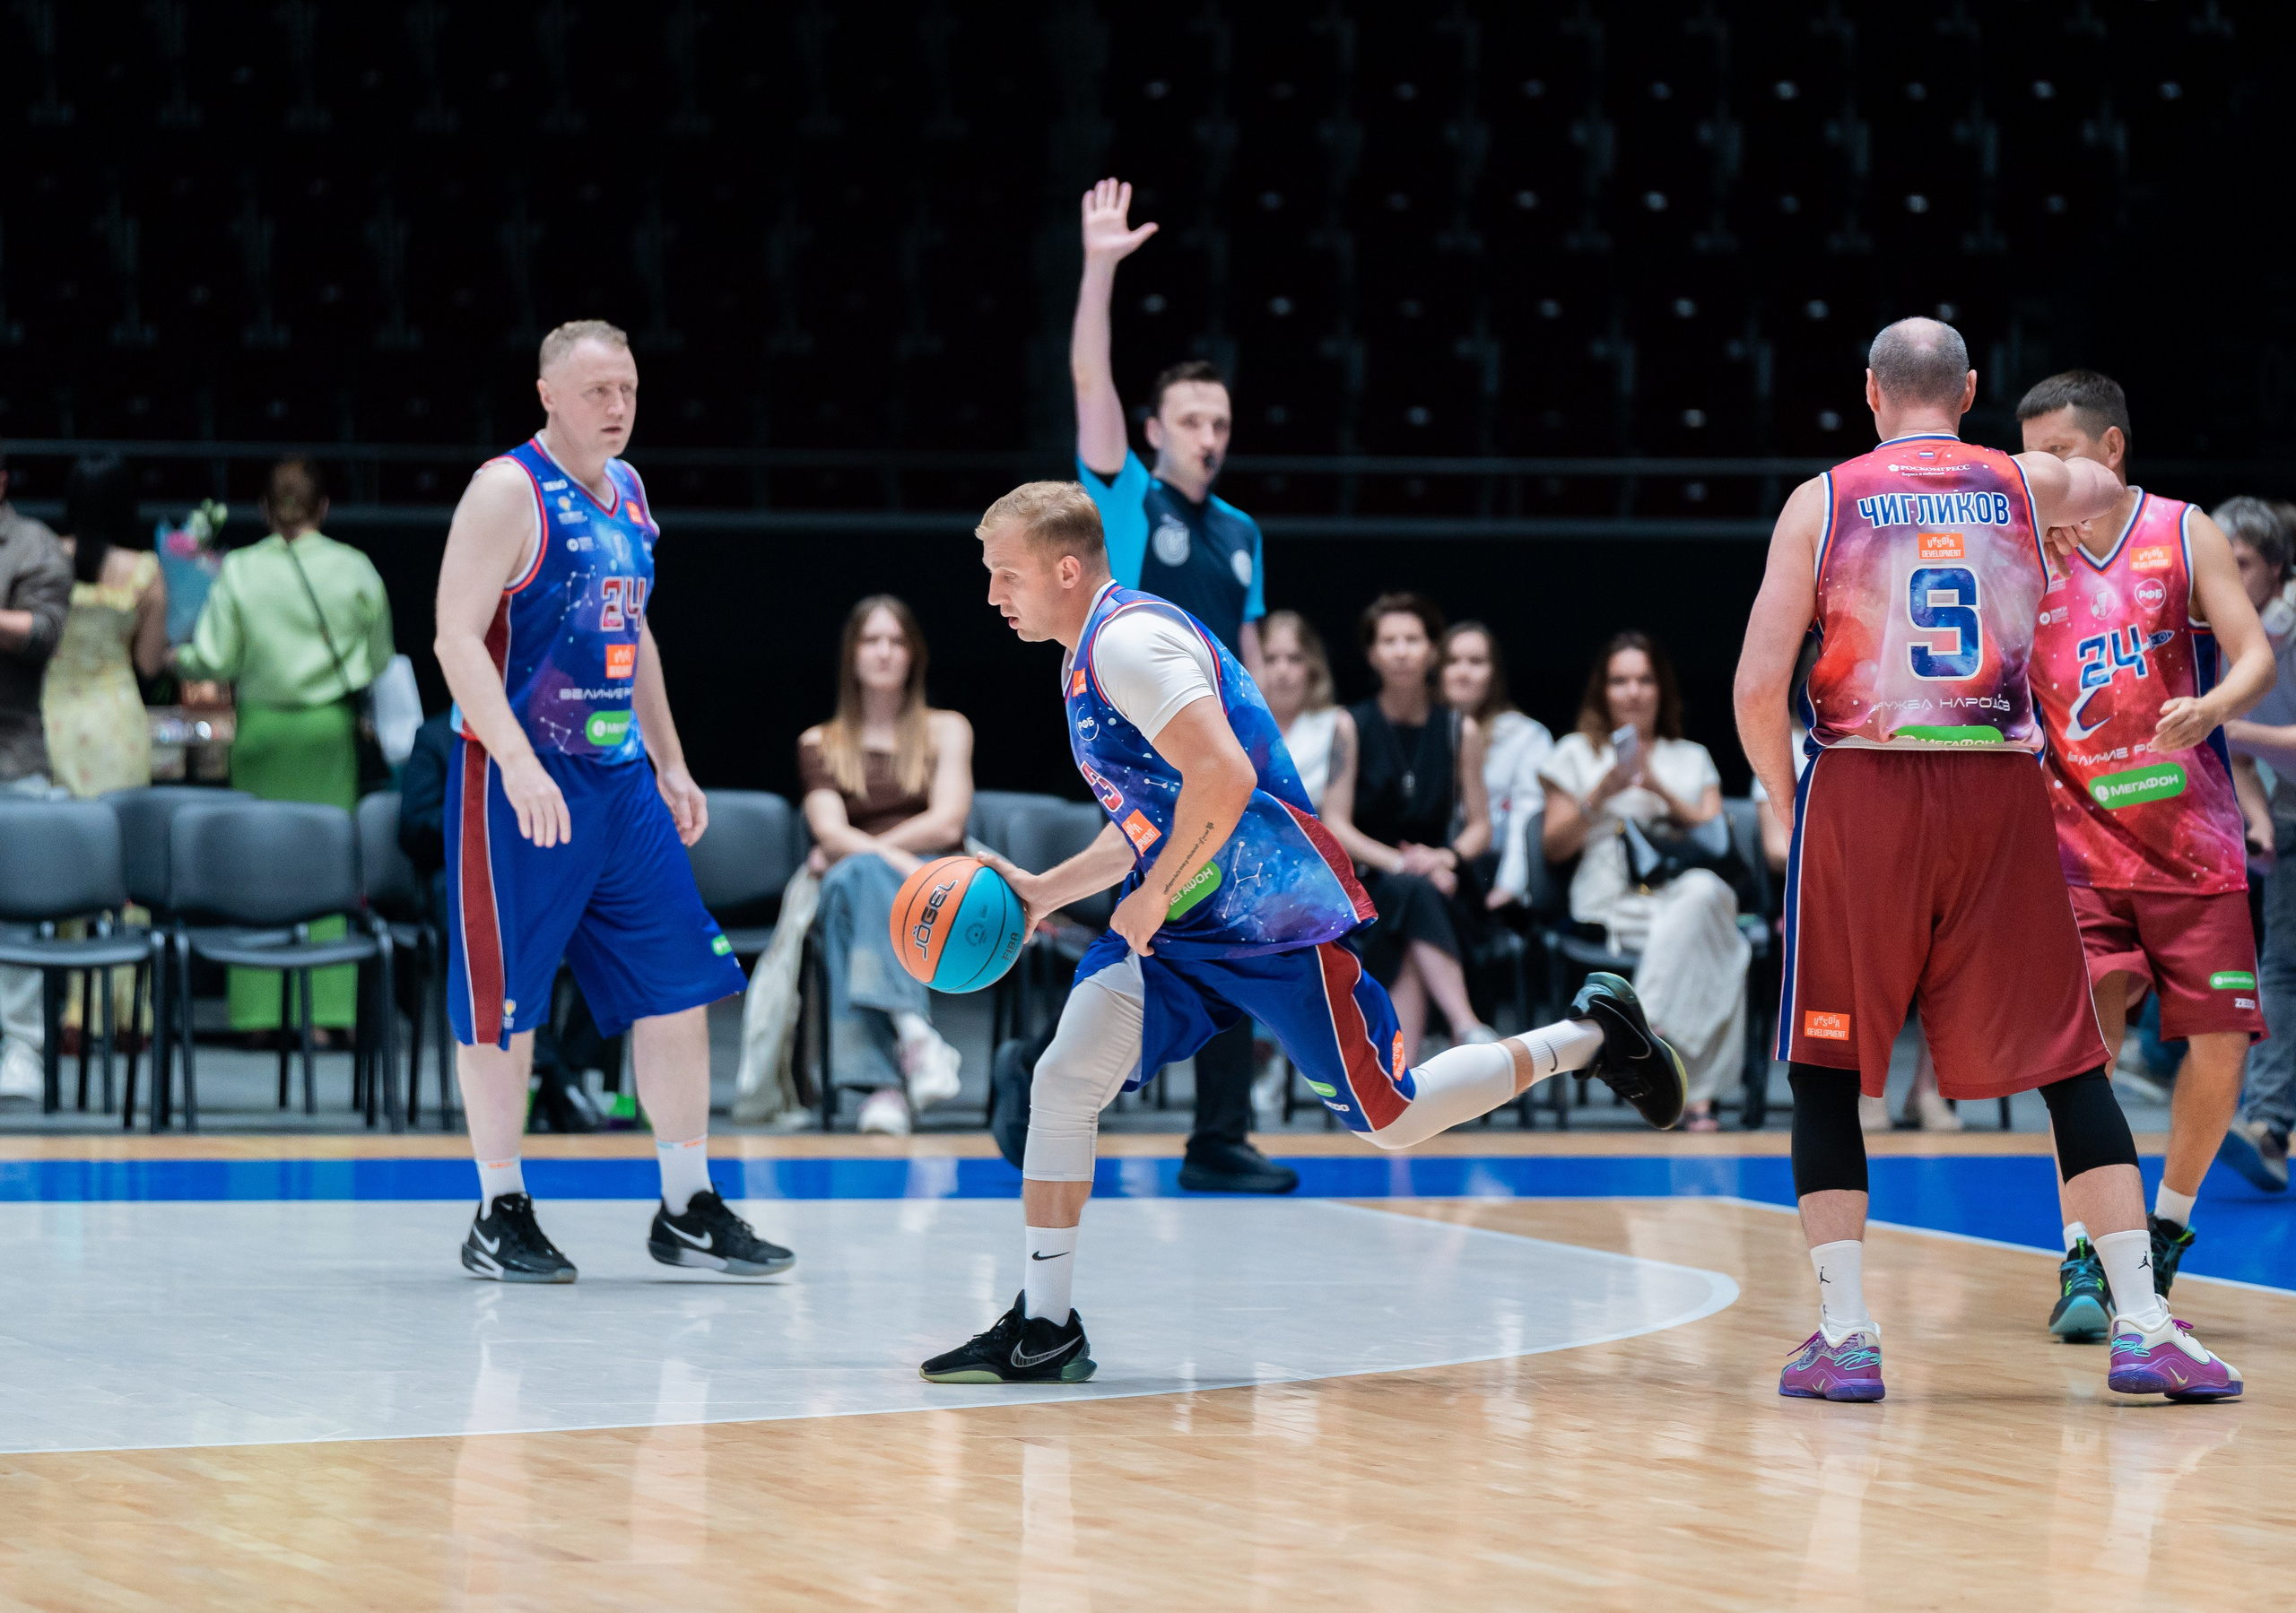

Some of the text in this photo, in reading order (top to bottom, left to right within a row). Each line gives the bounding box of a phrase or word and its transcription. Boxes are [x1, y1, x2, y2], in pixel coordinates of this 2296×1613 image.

[1857, 491, 2012, 529] ЧИГЛИКОВ
[1921, 549, 1961, 558] DEVELOPMENT
[599, 576, 647, 632] 24
[2138, 588, 2163, 600] РФБ
[2076, 623, 2149, 692] 24
[1078, 716, 1095, 732] РФБ
[2110, 774, 2179, 797] МЕГАФОН
[1170, 867, 1214, 906] ЕГАФОН
[1001, 932, 1020, 962] FIBA
[1806, 1028, 1846, 1038] DEVELOPMENT
